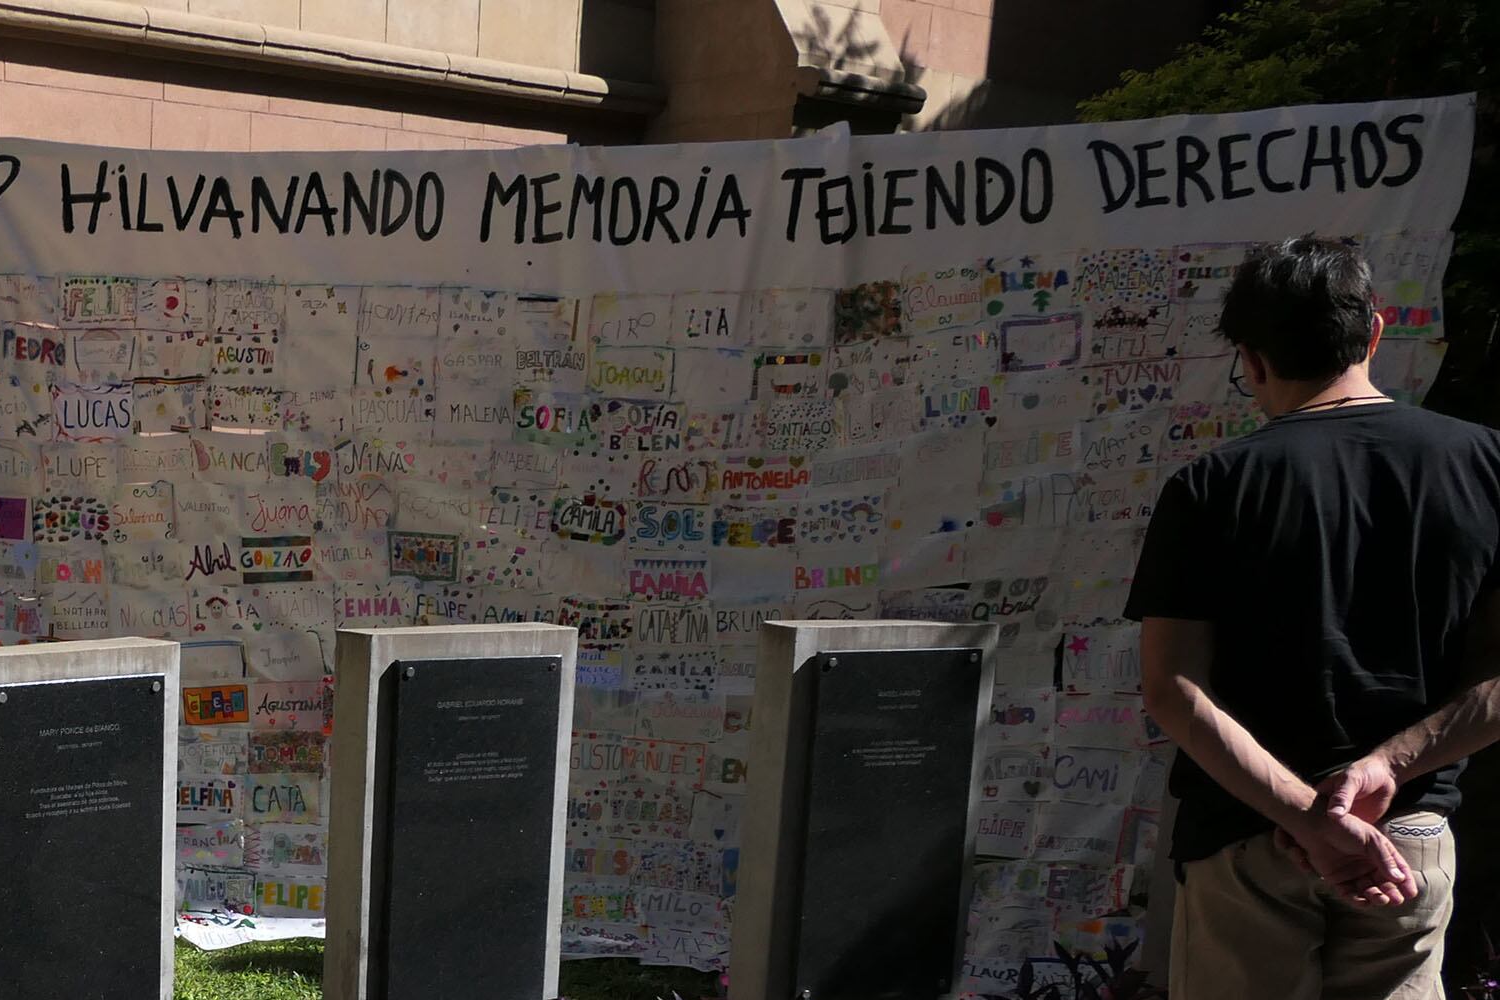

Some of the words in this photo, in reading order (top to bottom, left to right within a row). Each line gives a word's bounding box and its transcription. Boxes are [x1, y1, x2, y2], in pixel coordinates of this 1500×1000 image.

[1088, 114, 1424, 214] DERECHOS
[1074, 266, 1165, 293] MALENA
[3, 329, 67, 366] PEDRO
[217, 347, 275, 365] AGUSTIN
[444, 353, 503, 368] GASPAR
[63, 398, 132, 430] LUCAS
[359, 398, 427, 423] PASCUAL
[450, 403, 512, 424] MALENA
[925, 386, 990, 417] LUNA
[767, 420, 832, 437] SANTIAGO
[56, 455, 107, 480] LUPE
[722, 469, 809, 491] ANTONELLA
[248, 493, 315, 532] Juana
[560, 505, 616, 534] CAMILA
[636, 506, 704, 541] SOL
[185, 542, 238, 581] Abril
[241, 548, 312, 569] GONZALO
[320, 545, 372, 562] MICAELA
[628, 570, 709, 596] CAMILA
[795, 565, 879, 590] BRUNO
[345, 596, 402, 617] EMMA
[416, 594, 468, 621] FELIPE
[638, 608, 709, 644] CATALINA
[254, 745, 323, 764] TOMAS
[622, 746, 694, 774] MANUEL
[1053, 755, 1119, 791] CAMI
[176, 786, 234, 807] ELFINA
[253, 785, 307, 813] CATA
[256, 881, 324, 911] FELIPE
